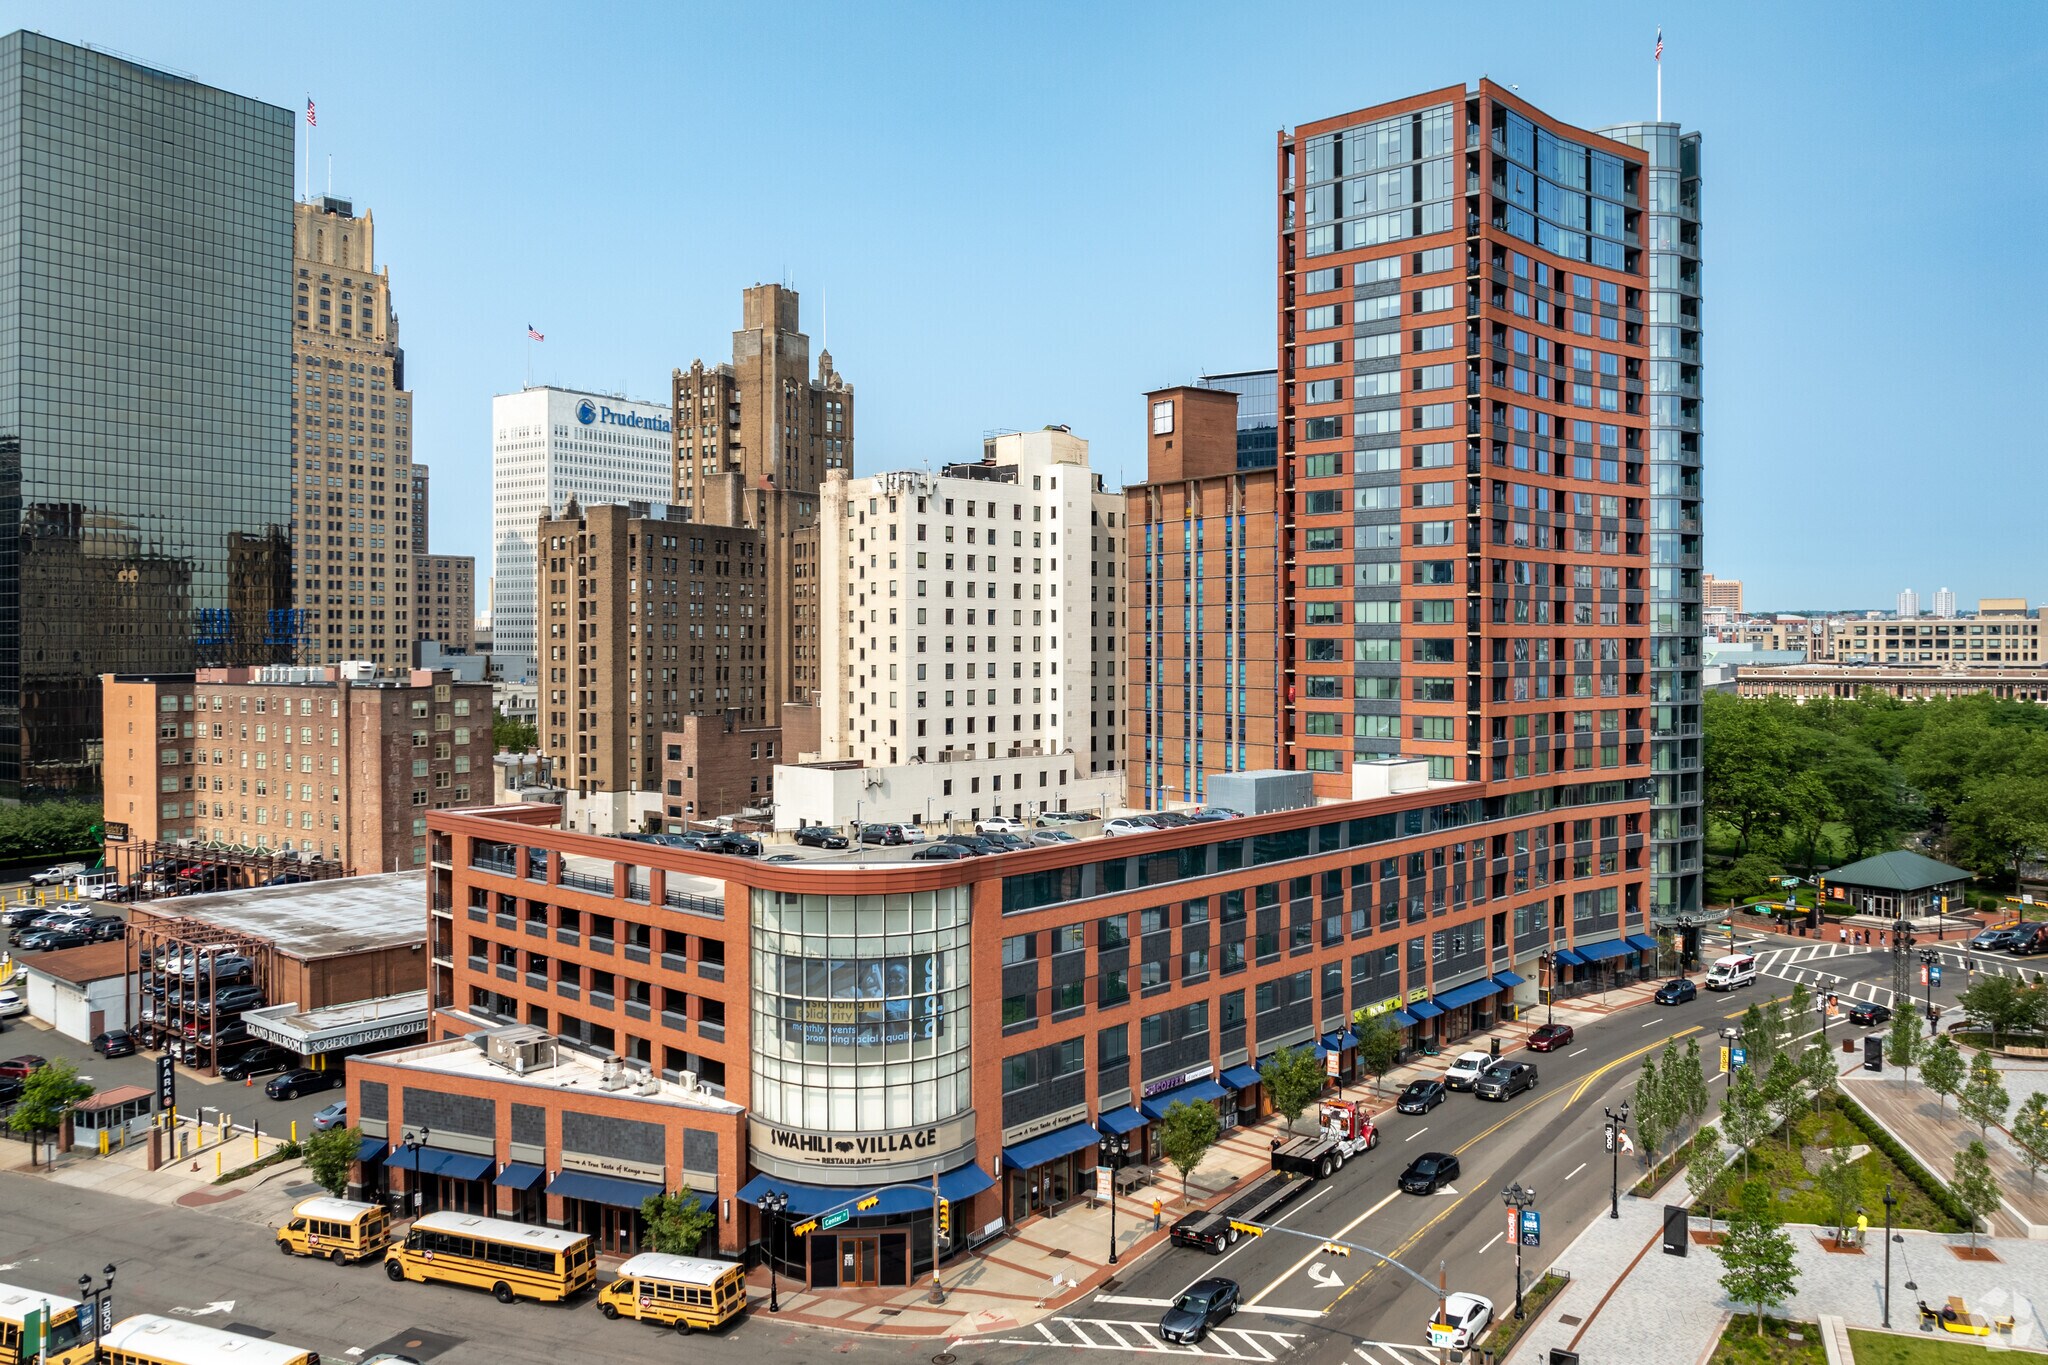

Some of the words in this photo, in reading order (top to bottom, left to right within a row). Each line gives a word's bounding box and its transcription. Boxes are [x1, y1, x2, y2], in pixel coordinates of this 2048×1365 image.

[311, 1035, 353, 1052] ROBERT
[356, 1027, 389, 1043] TREAT
[394, 1019, 429, 1036] HOTEL
[827, 1026, 855, 1034] vents
[247, 1023, 268, 1039] GRAND
[268, 1030, 301, 1053] BALLROOM
[806, 1035, 849, 1045] promting
[163, 1058, 172, 1097] PARK
[1040, 1121, 1051, 1129] Taste
[1052, 1117, 1057, 1126] of
[1058, 1114, 1072, 1123] Kenya
[771, 1128, 832, 1153] SWAHILI
[856, 1128, 936, 1154] VILLAGE
[821, 1157, 873, 1165] RESTAURANT
[616, 1164, 622, 1173] of
[624, 1167, 641, 1176] Kenya
[825, 1215, 842, 1226] Center
[102, 1300, 112, 1331] njpac
